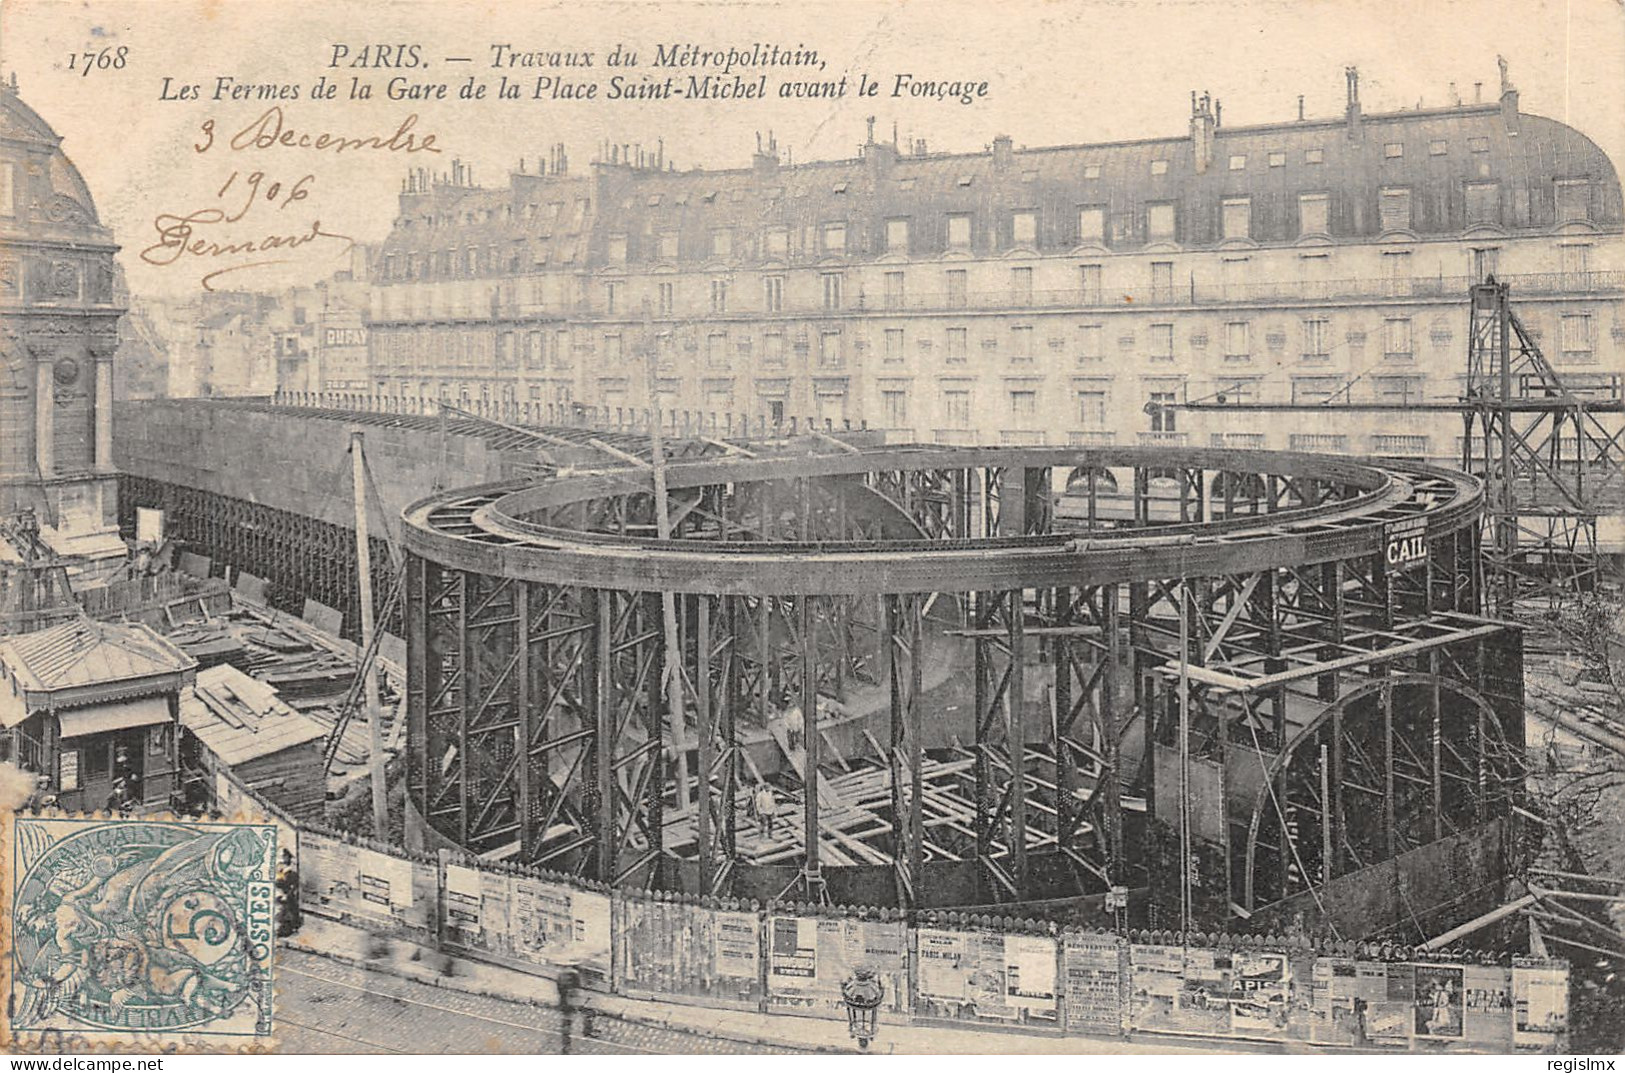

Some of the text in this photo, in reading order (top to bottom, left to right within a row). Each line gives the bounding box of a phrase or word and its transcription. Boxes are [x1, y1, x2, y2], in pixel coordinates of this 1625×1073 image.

[194, 119, 215, 153] 3
[217, 170, 315, 223] 1906
[1387, 536, 1427, 564] CAIL
